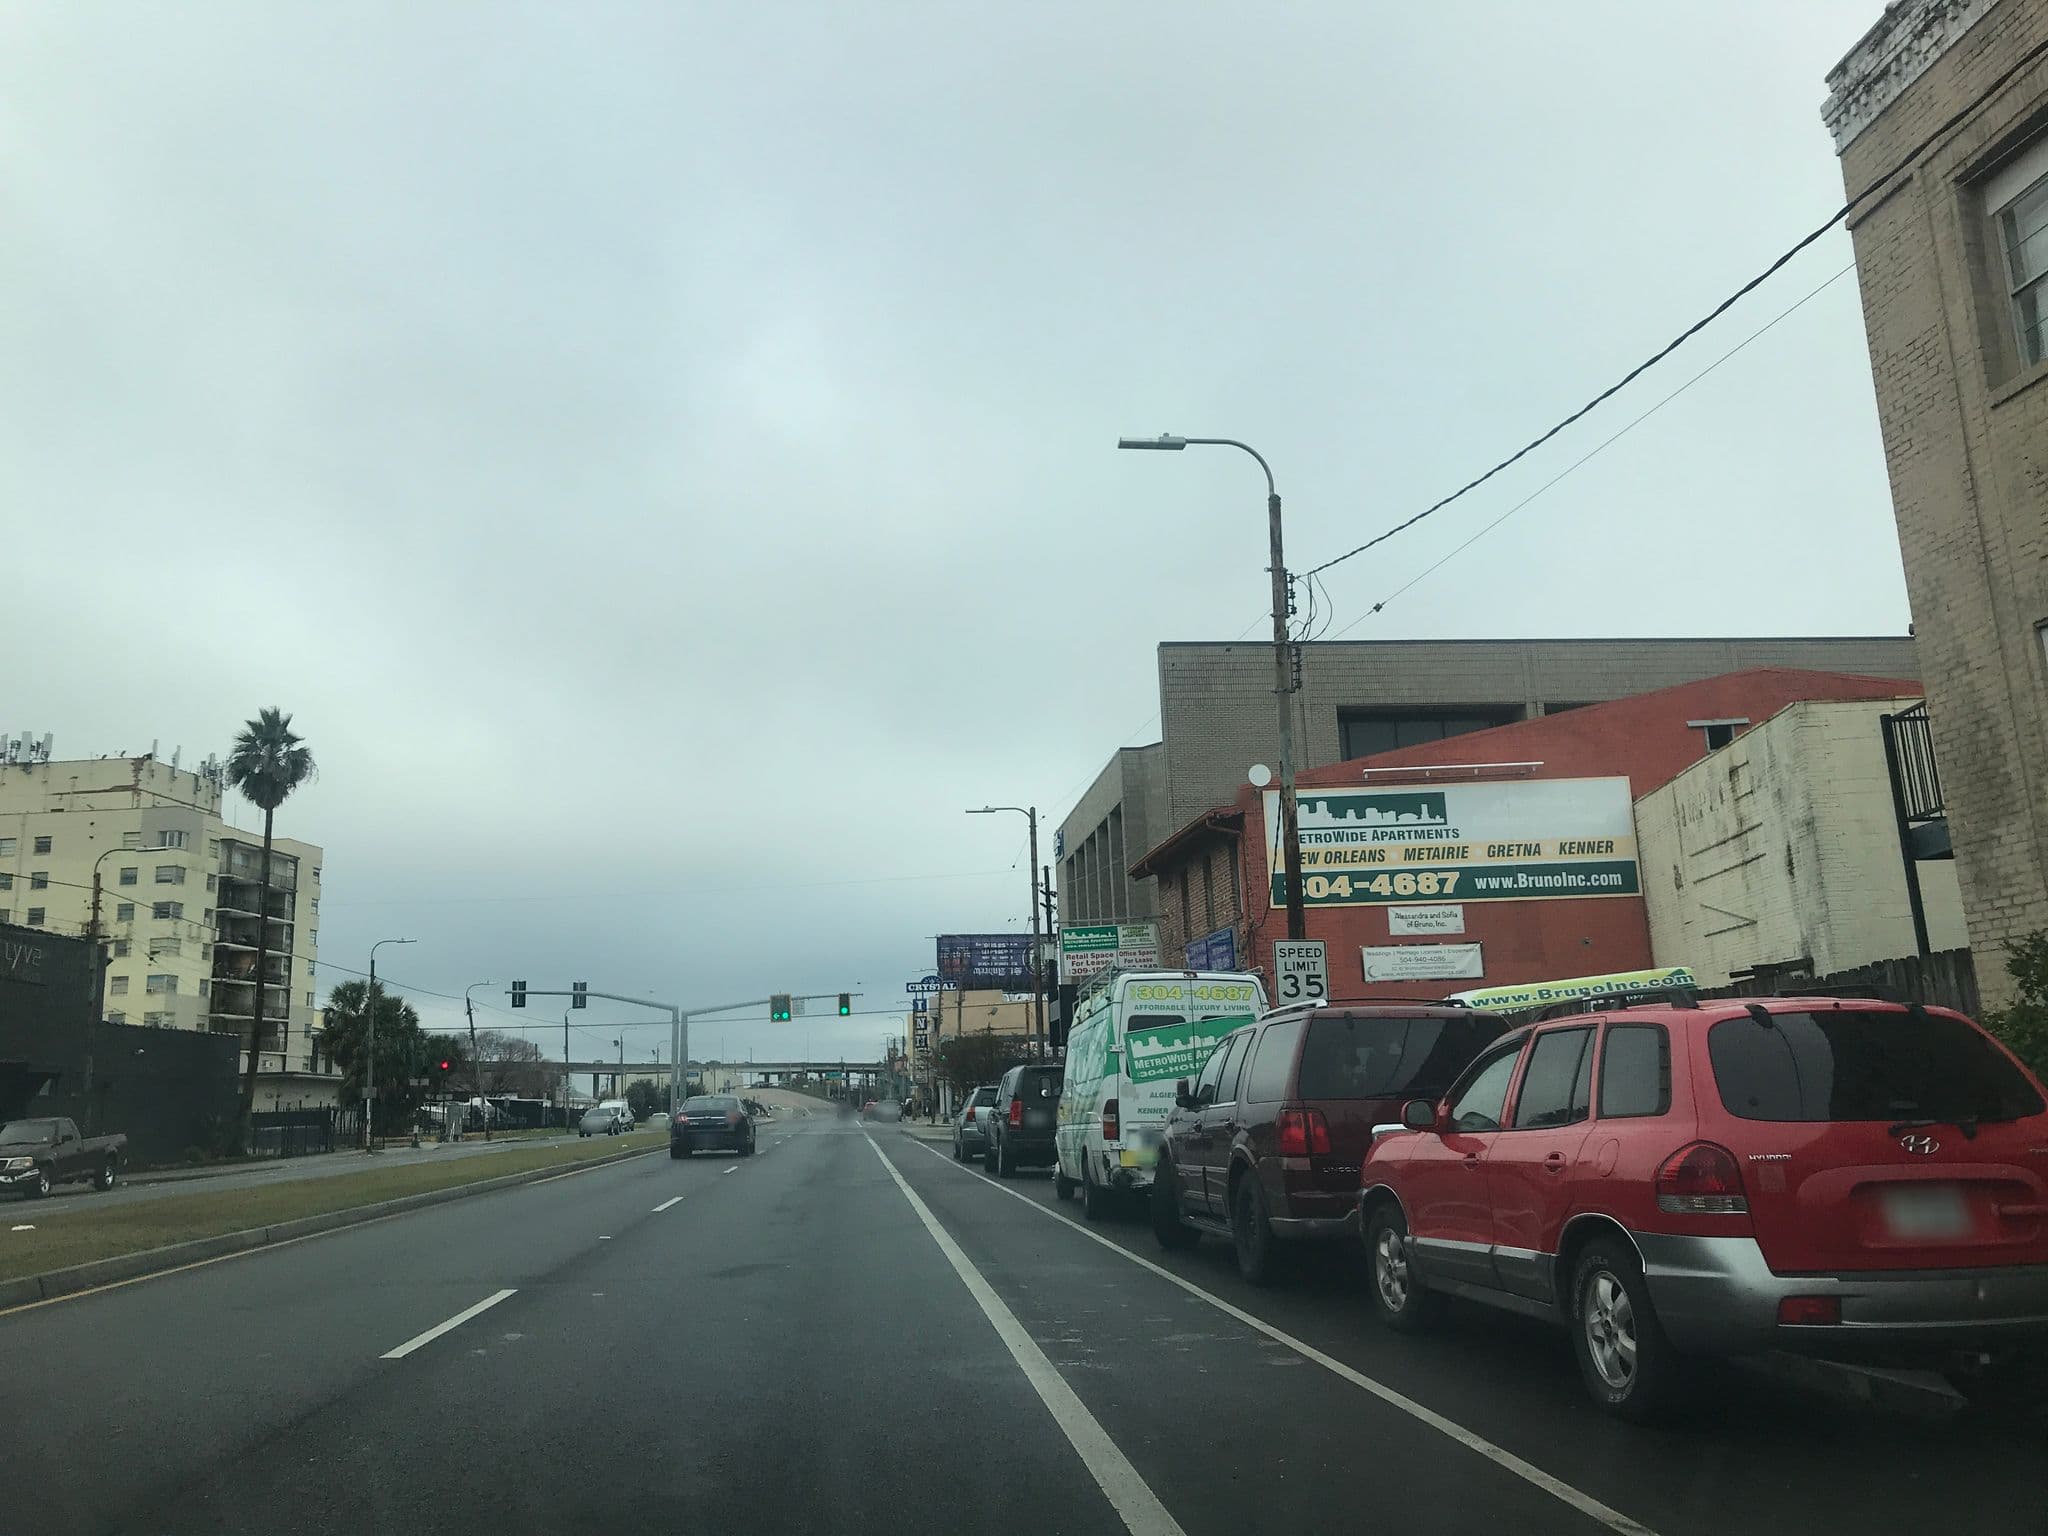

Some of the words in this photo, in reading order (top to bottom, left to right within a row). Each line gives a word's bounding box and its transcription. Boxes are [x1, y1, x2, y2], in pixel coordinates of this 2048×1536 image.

[1299, 830, 1367, 844] ETROWIDE
[1371, 828, 1460, 842] APARTMENTS
[1299, 851, 1320, 865] EW
[1324, 849, 1386, 864] ORLEANS
[1403, 846, 1470, 861] METAIRIE
[1487, 843, 1542, 858] GRETNA
[1558, 840, 1614, 855] KENNER
[1301, 871, 1460, 899] 04-4687
[1474, 871, 1623, 890] www.BrunoInc.com
[1429, 911, 1441, 919] and
[1065, 952, 1089, 961] Retail
[1278, 947, 1322, 958] SPEED
[1284, 961, 1318, 972] LIMIT
[907, 982, 957, 992] CRYSTAL
[1136, 984, 1255, 1001] 304-4687
[1282, 974, 1324, 998] 35
[1471, 973, 1697, 1009] www.BrunoInc.com
[1134, 1052, 1193, 1070] METROWIDE
[1137, 1107, 1169, 1115] KENNER
